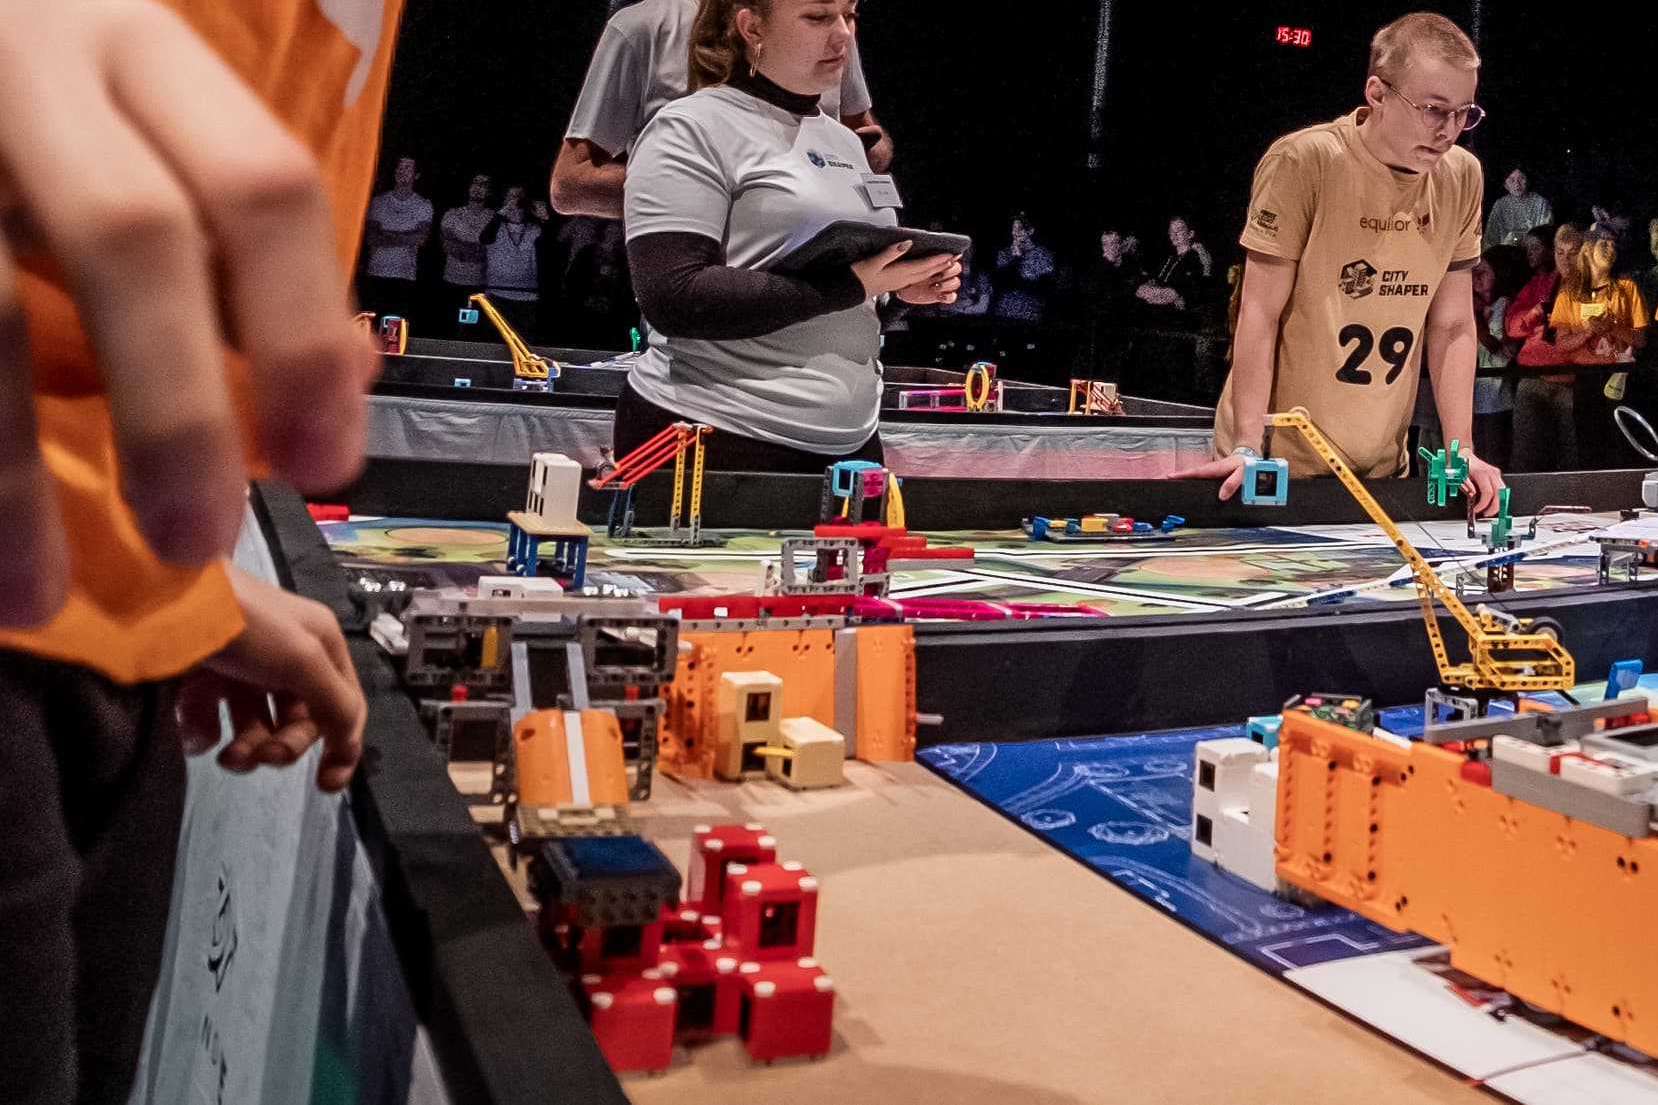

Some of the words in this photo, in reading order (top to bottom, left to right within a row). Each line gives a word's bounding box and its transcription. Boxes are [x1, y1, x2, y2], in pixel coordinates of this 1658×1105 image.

[1360, 216, 1411, 233] equior
[1382, 270, 1409, 282] CITY
[1379, 284, 1429, 296] SHAPER
[1335, 323, 1414, 385] 29
